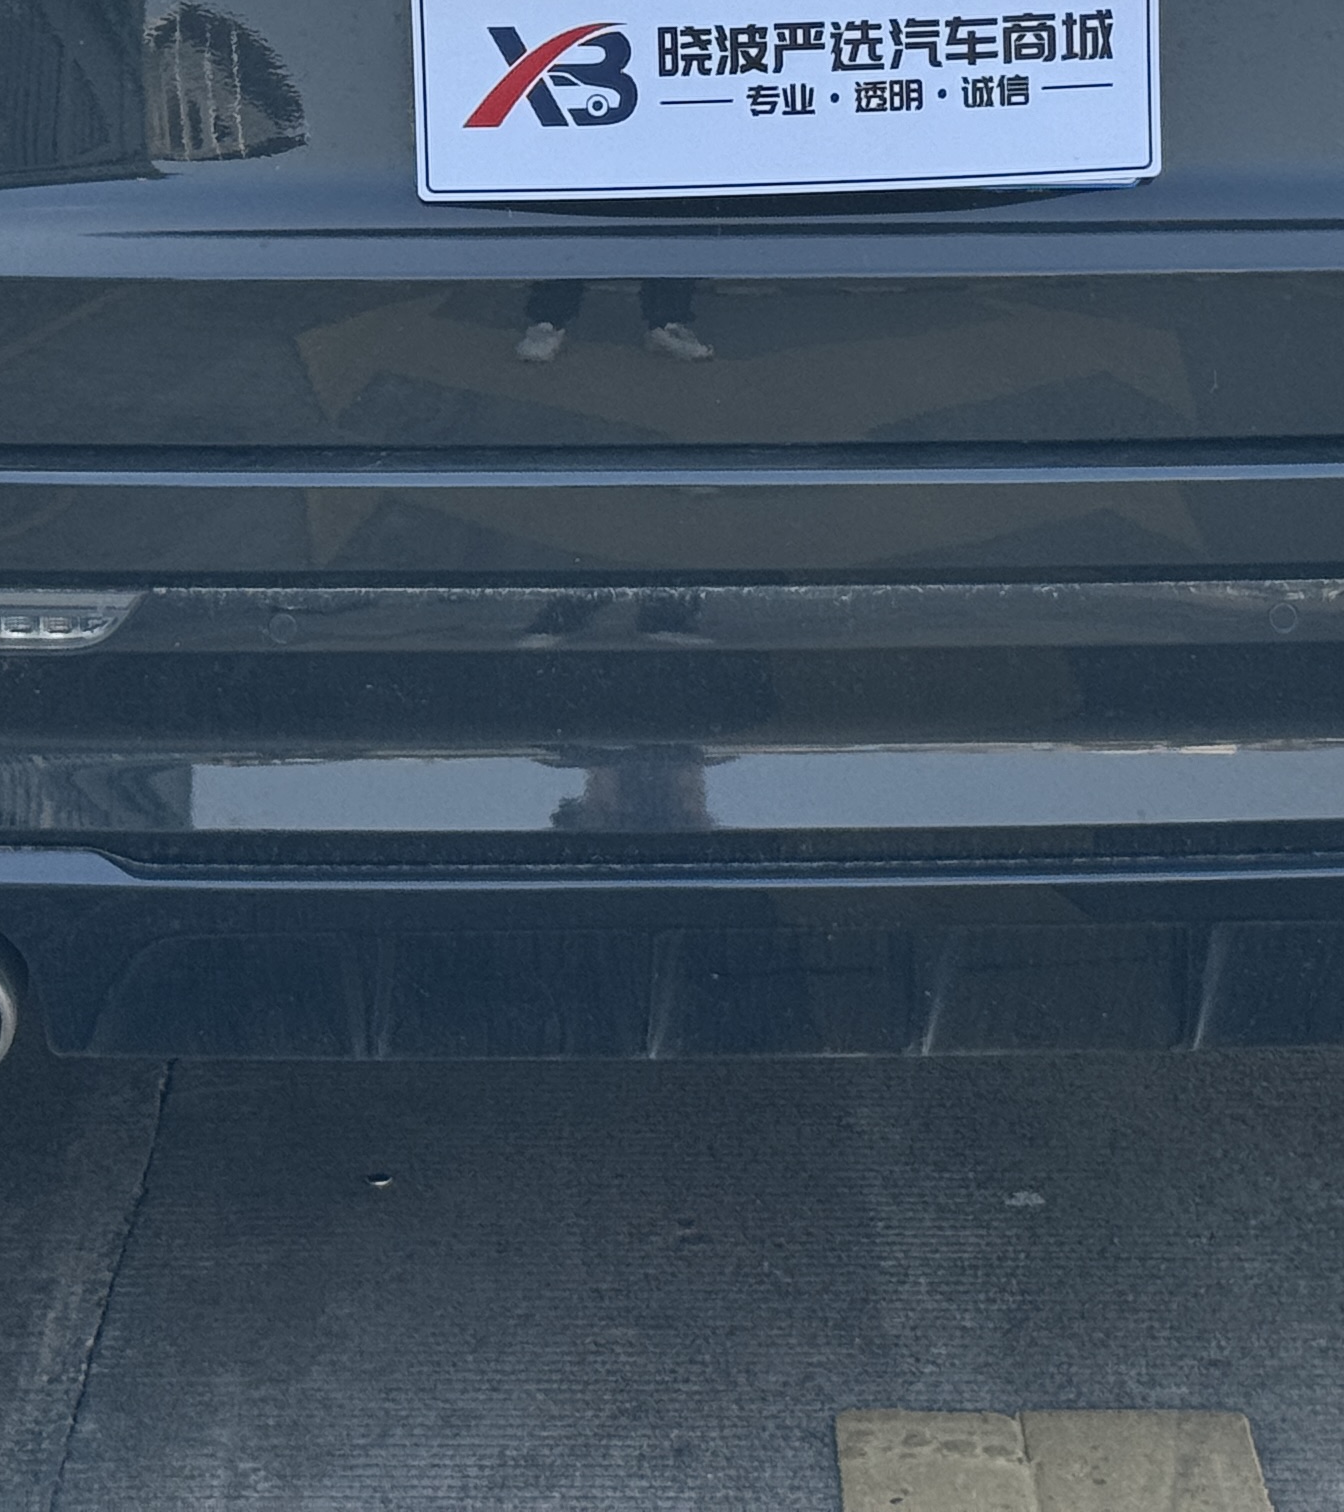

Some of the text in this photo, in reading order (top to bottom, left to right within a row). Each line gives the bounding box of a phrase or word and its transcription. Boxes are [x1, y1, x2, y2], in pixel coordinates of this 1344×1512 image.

[658, 9, 1114, 77] 晓波严选汽车商城
